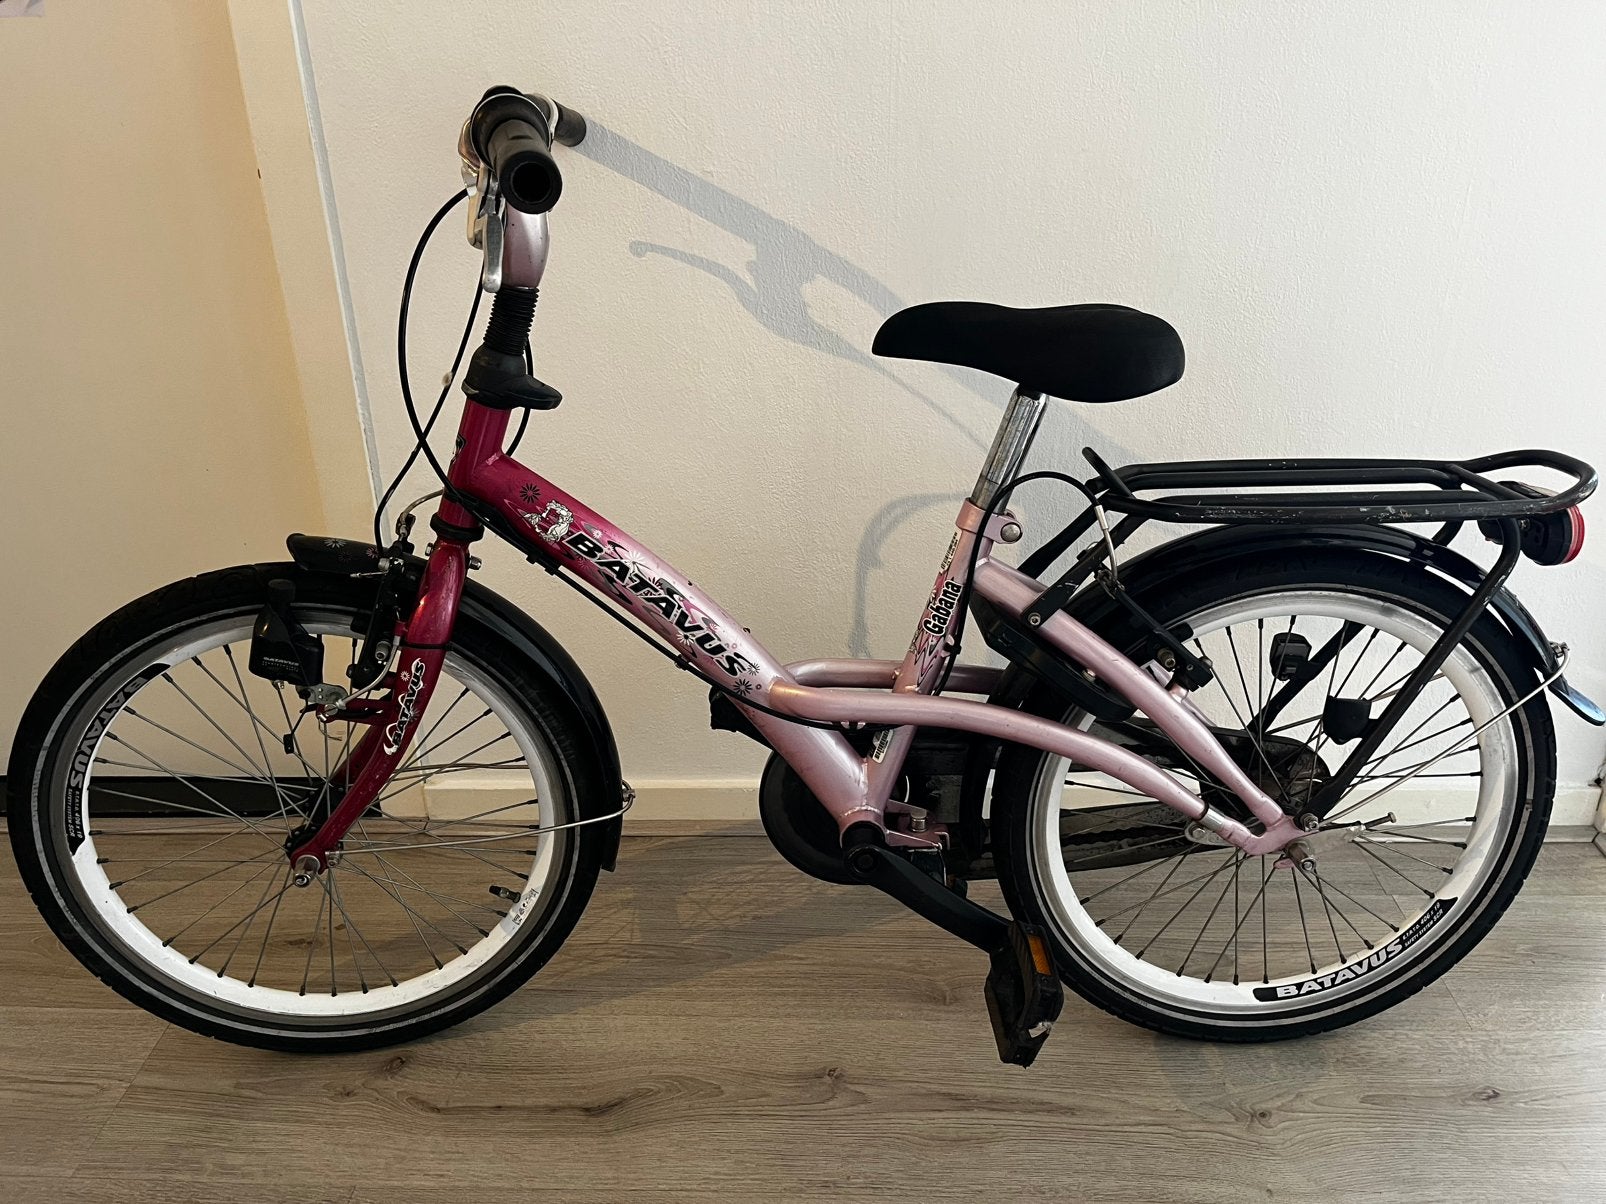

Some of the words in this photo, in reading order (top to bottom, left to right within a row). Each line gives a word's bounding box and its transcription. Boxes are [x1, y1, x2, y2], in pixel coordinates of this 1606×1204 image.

[563, 531, 747, 677] BATAVUS
[922, 579, 964, 636] Gabana
[70, 676, 149, 789] BATAVUS
[391, 660, 425, 746] BATAVUS
[1276, 938, 1403, 998] BATAVUS
[1404, 933, 1419, 948] SAFETY
